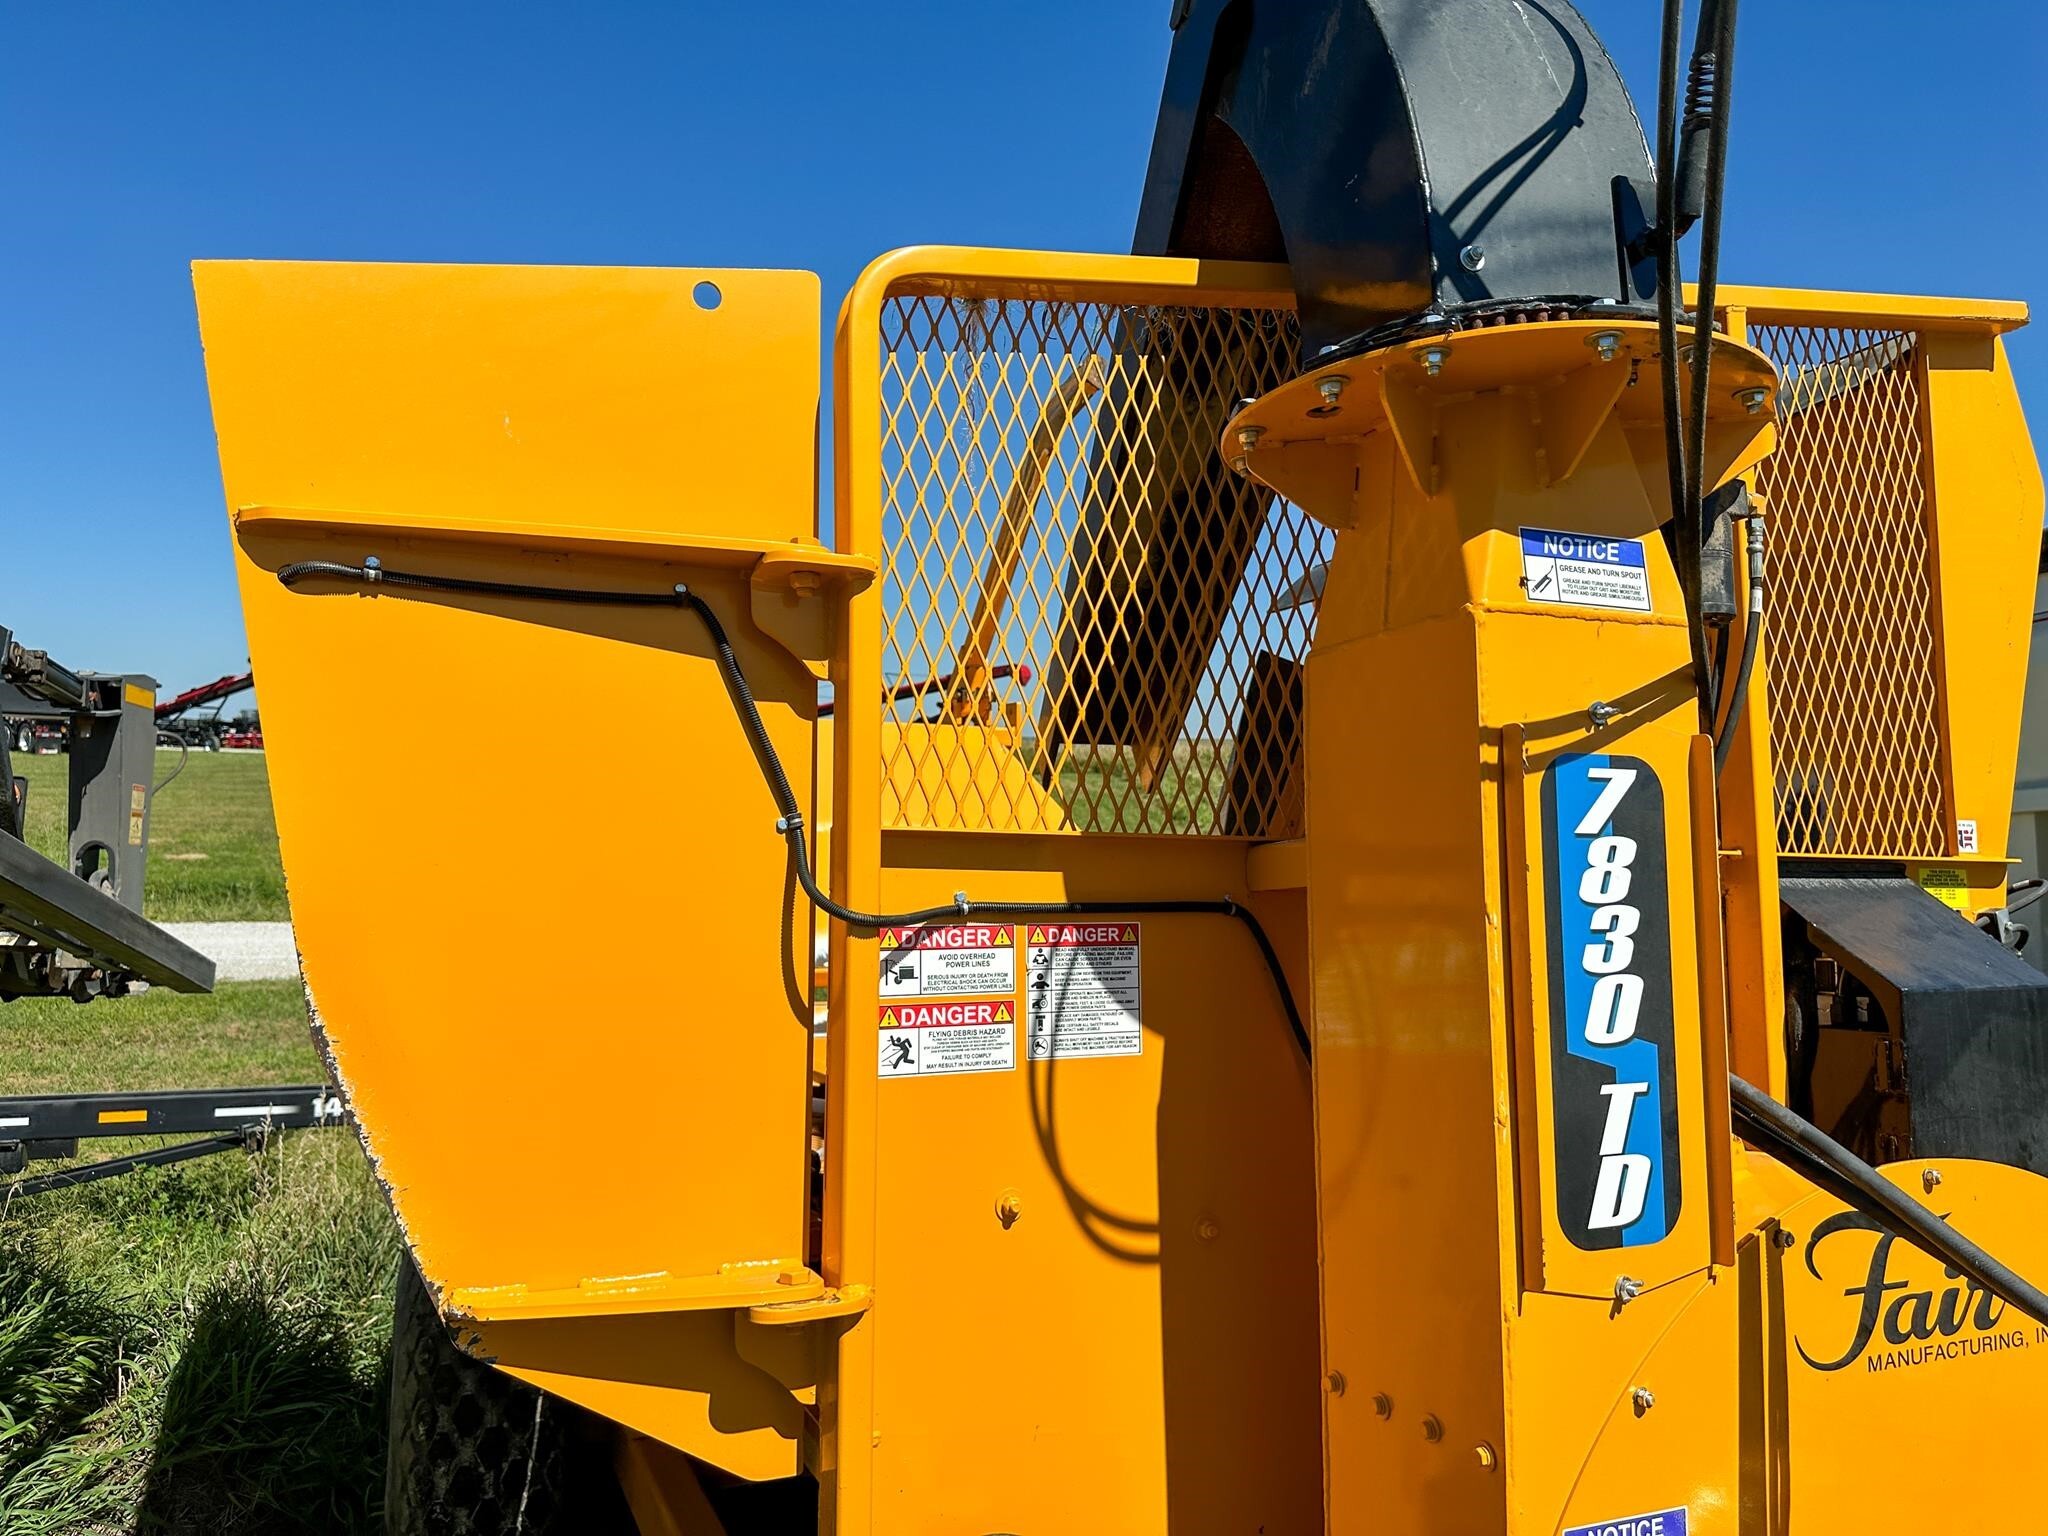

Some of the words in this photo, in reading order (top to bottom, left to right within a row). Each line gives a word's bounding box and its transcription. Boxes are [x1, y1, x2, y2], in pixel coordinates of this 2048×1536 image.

[1543, 534, 1620, 562] NOTICE
[1560, 564, 1586, 574] GREASE
[1587, 567, 1601, 576] AND
[1602, 569, 1620, 577] TURN
[1621, 571, 1641, 580] SPOUT
[1573, 767, 1645, 1045] 7830
[901, 928, 992, 948] DANGER
[1048, 927, 1120, 943] DANGER
[900, 1005, 993, 1026] DANGER
[1587, 1081, 1652, 1230] TD
[1794, 1210, 2006, 1372] Fair
[1866, 1330, 2029, 1373] MANUFACTURING,
